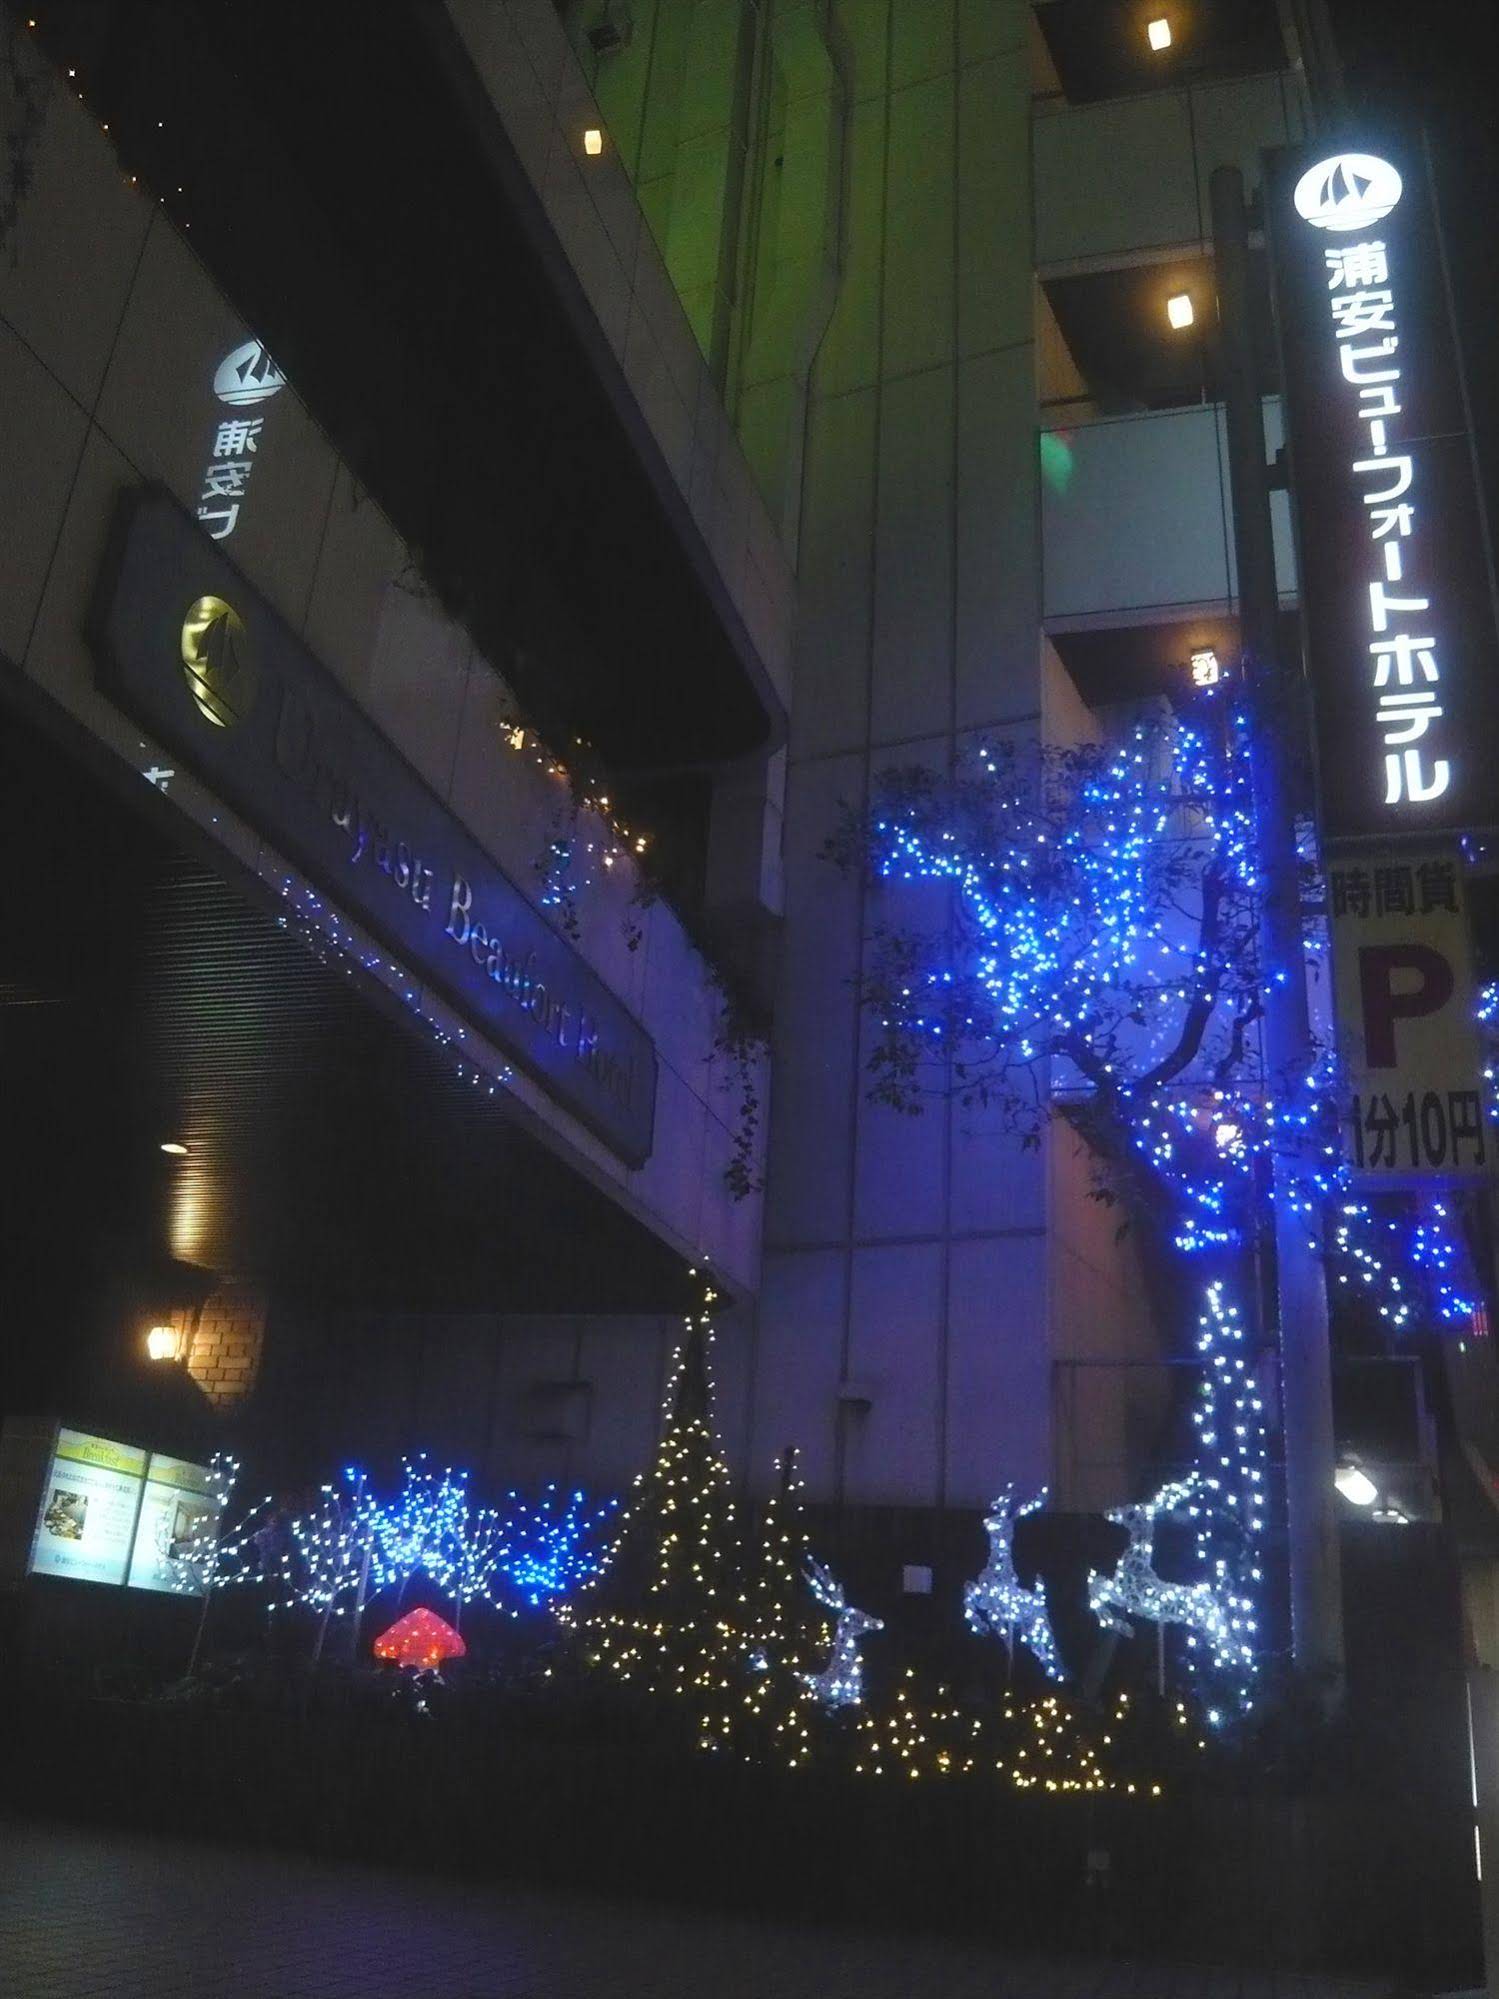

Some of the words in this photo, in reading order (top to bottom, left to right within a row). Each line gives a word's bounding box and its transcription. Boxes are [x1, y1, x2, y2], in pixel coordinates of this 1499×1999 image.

[1325, 240, 1450, 804] 浦安ビューフォートホテル
[1358, 945, 1455, 1069] P
[1346, 1091, 1485, 1168] 1分10円
